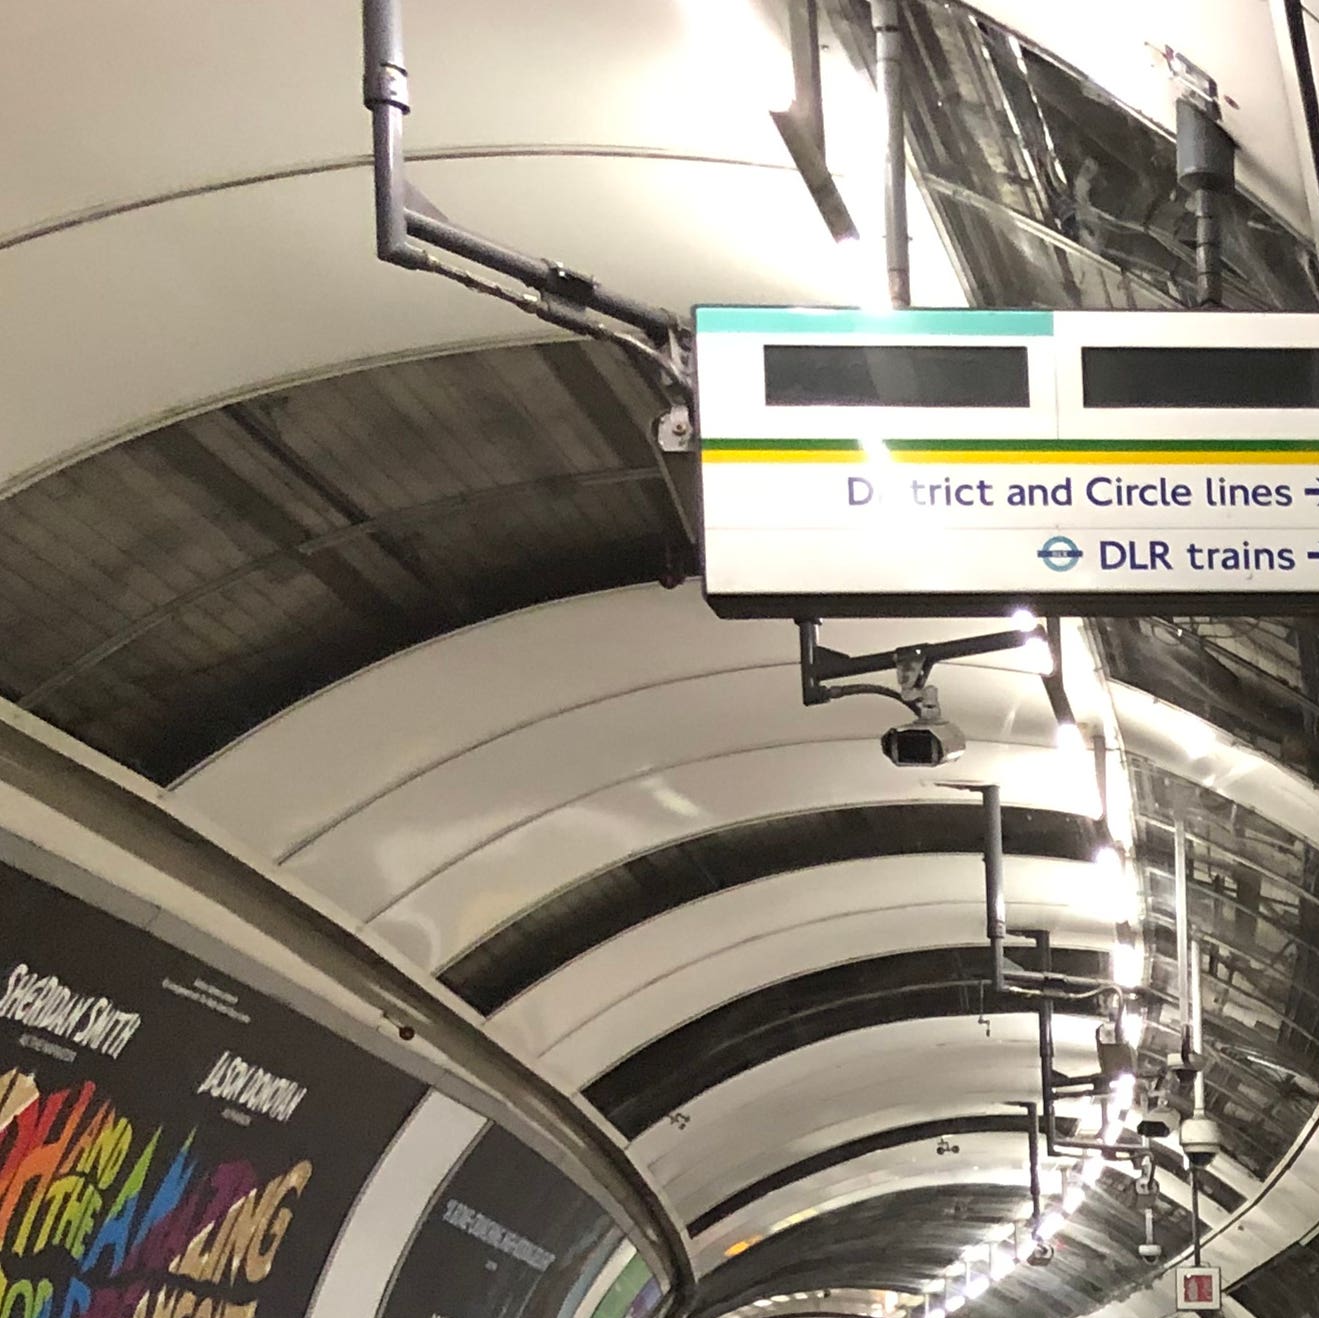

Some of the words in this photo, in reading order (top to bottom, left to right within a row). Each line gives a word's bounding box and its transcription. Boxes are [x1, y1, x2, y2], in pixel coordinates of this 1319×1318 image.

[848, 476, 993, 506] Dtrict
[1007, 477, 1072, 506] and
[1086, 477, 1192, 506] Circle
[1206, 478, 1293, 506] lines
[1100, 541, 1173, 570] DLR
[1187, 541, 1296, 570] trains
[73, 996, 142, 1060] SMITH
[57, 1098, 133, 1190] AND
[33, 1174, 103, 1260] THE
